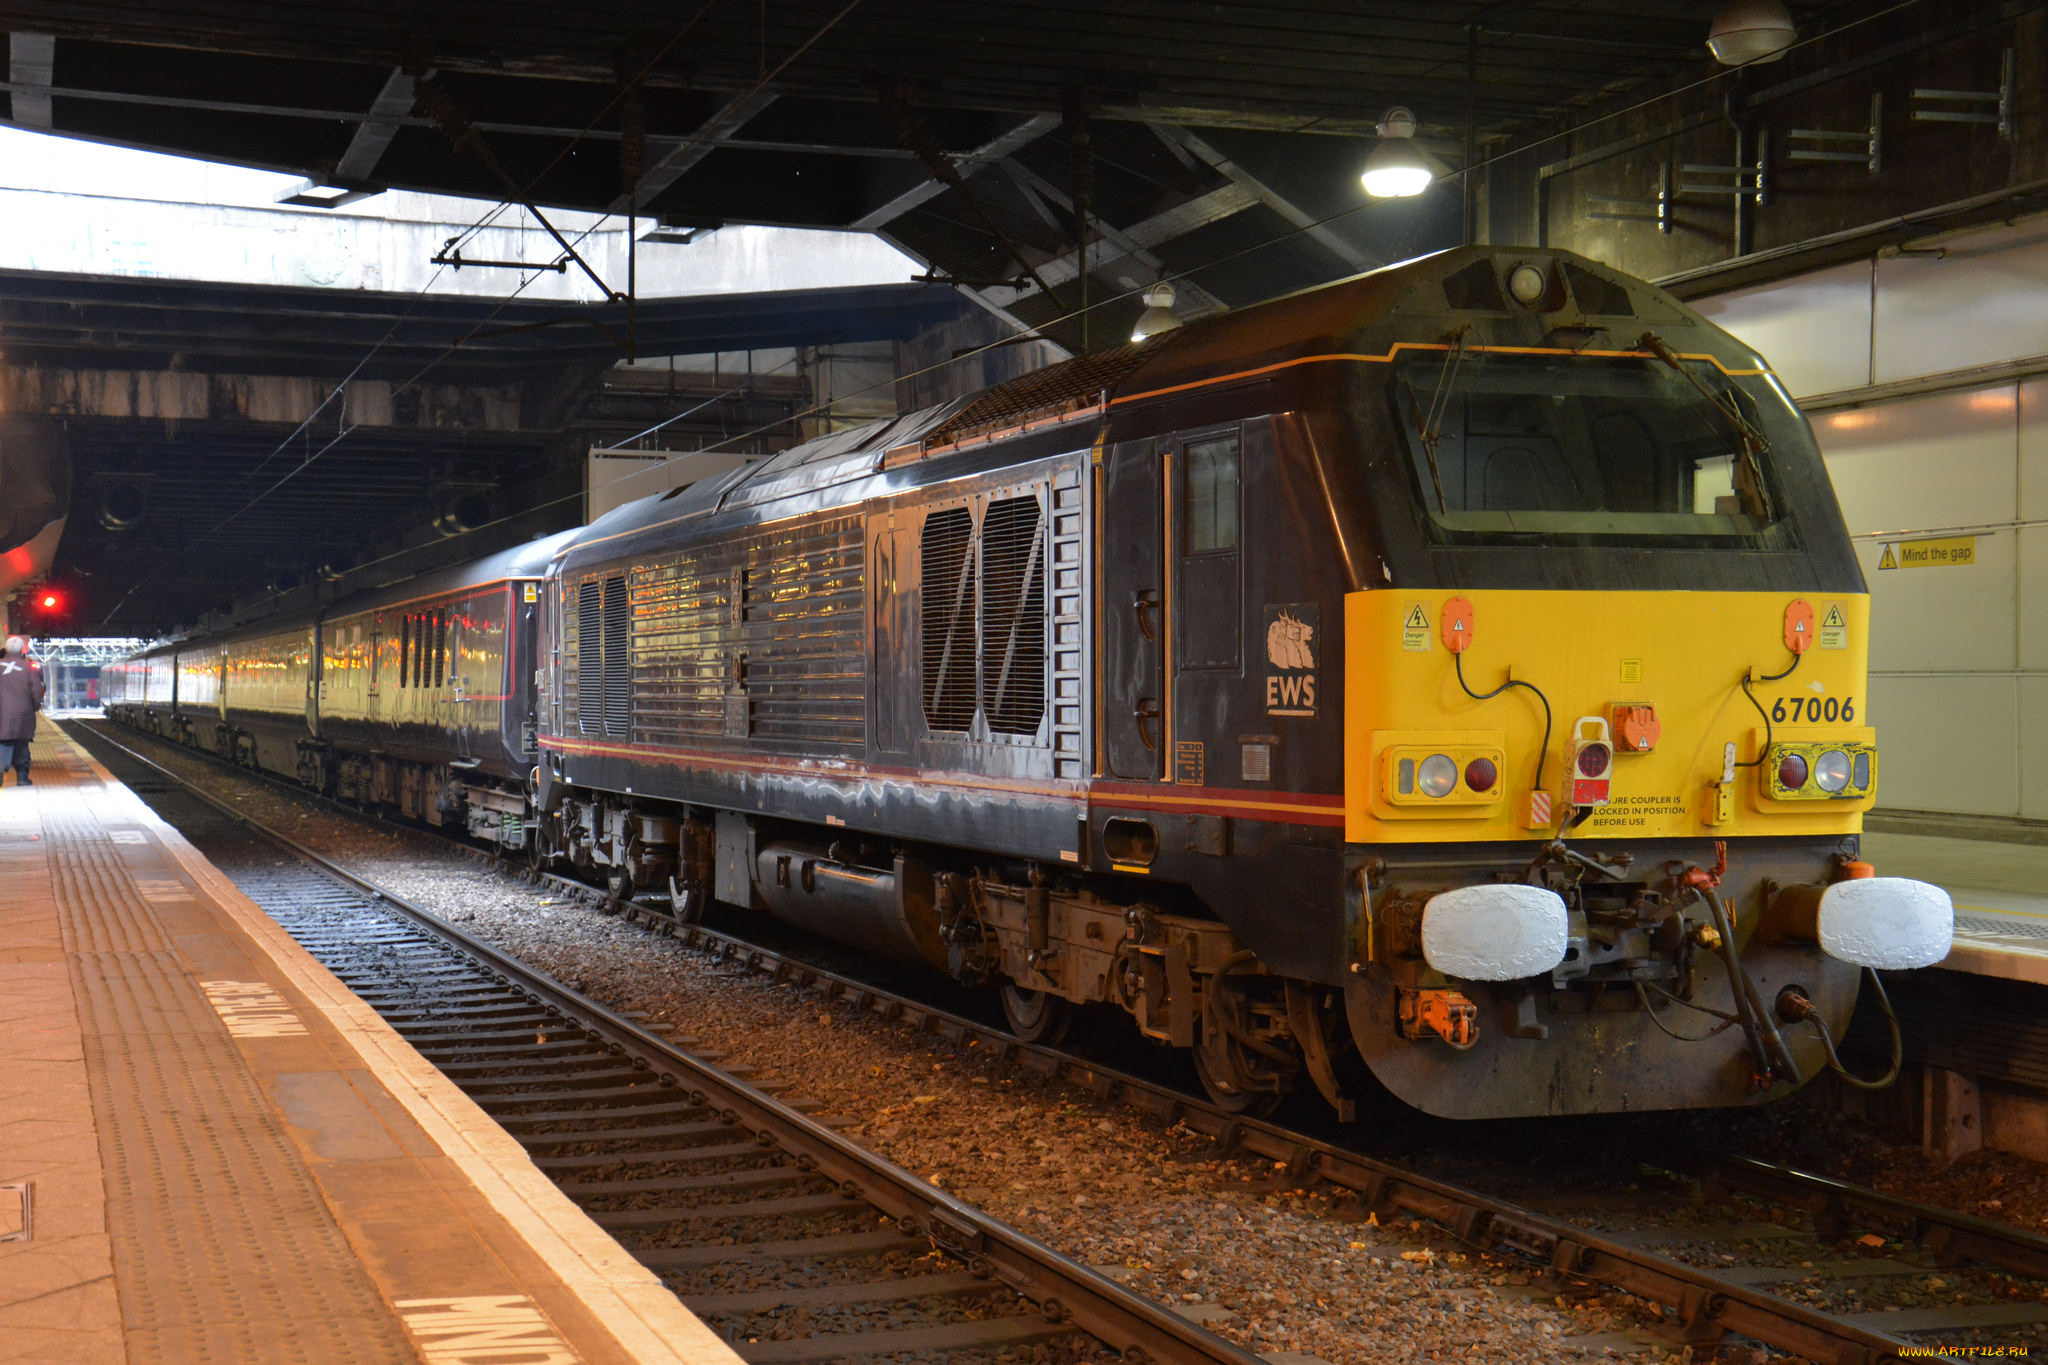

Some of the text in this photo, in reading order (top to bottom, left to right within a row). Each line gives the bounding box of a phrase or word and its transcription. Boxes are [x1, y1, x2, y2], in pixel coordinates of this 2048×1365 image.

[1902, 547, 1972, 562] Mind the gap
[1266, 674, 1316, 708] EWS
[1771, 697, 1855, 723] 67006
[1630, 796, 1670, 805] COUPLER
[1673, 796, 1682, 804] IS
[1593, 806, 1686, 816] LOCKED IN POSITION
[1593, 817, 1646, 826] BEFORE USE
[209, 994, 290, 1015] THE
